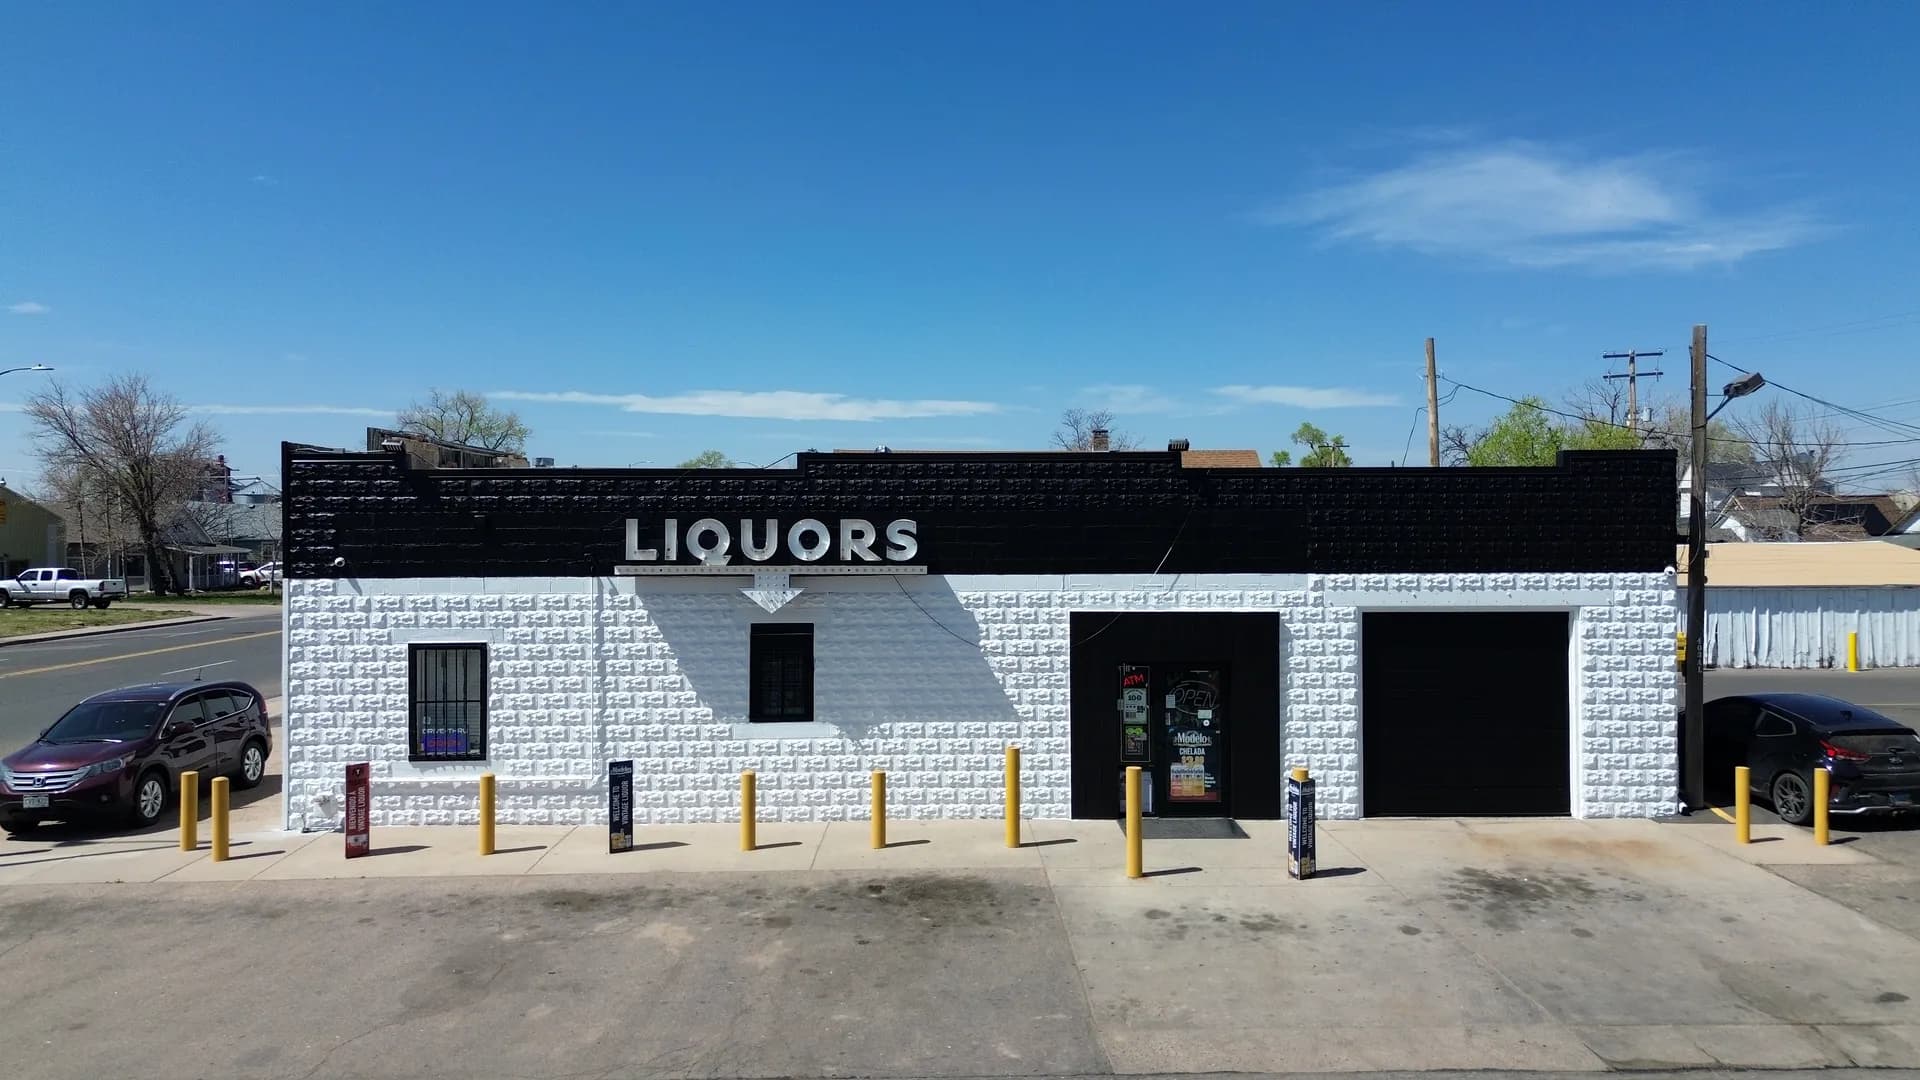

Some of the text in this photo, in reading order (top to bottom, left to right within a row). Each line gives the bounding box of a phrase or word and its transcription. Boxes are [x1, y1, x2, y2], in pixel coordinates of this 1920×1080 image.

[625, 519, 917, 566] LIQUORS
[1123, 674, 1145, 687] ATM
[1172, 687, 1218, 708] OPEN
[1177, 731, 1208, 744] Modelo
[1179, 747, 1205, 756] CHELADA
[357, 786, 366, 808] LIQUOR
[612, 785, 620, 822] WELCOME TO
[621, 780, 629, 825] VINTAGE LIQUOR
[357, 808, 366, 832] VINTAGE
